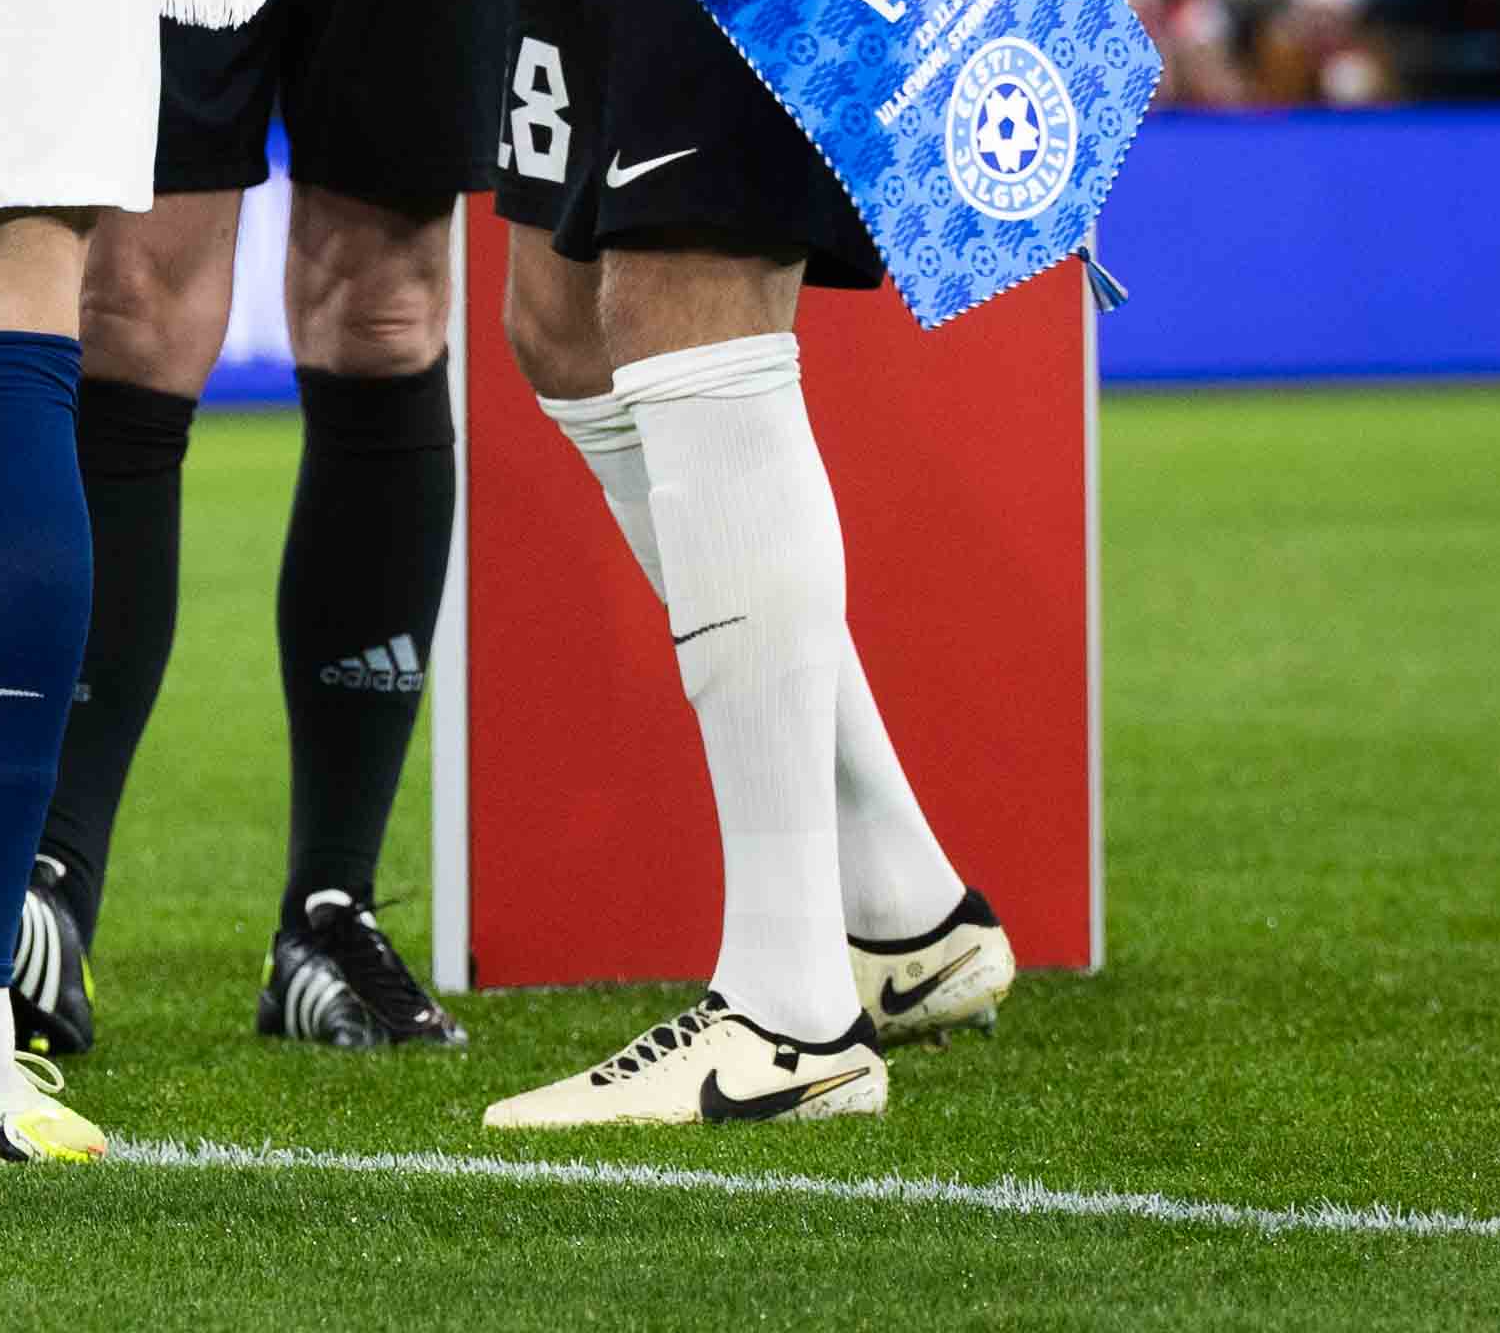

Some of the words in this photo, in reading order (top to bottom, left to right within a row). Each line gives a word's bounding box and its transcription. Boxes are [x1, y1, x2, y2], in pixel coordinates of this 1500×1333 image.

[497, 36, 572, 184] 8
[957, 49, 1011, 118] EESTI
[956, 138, 1067, 208] JALGPALLI
